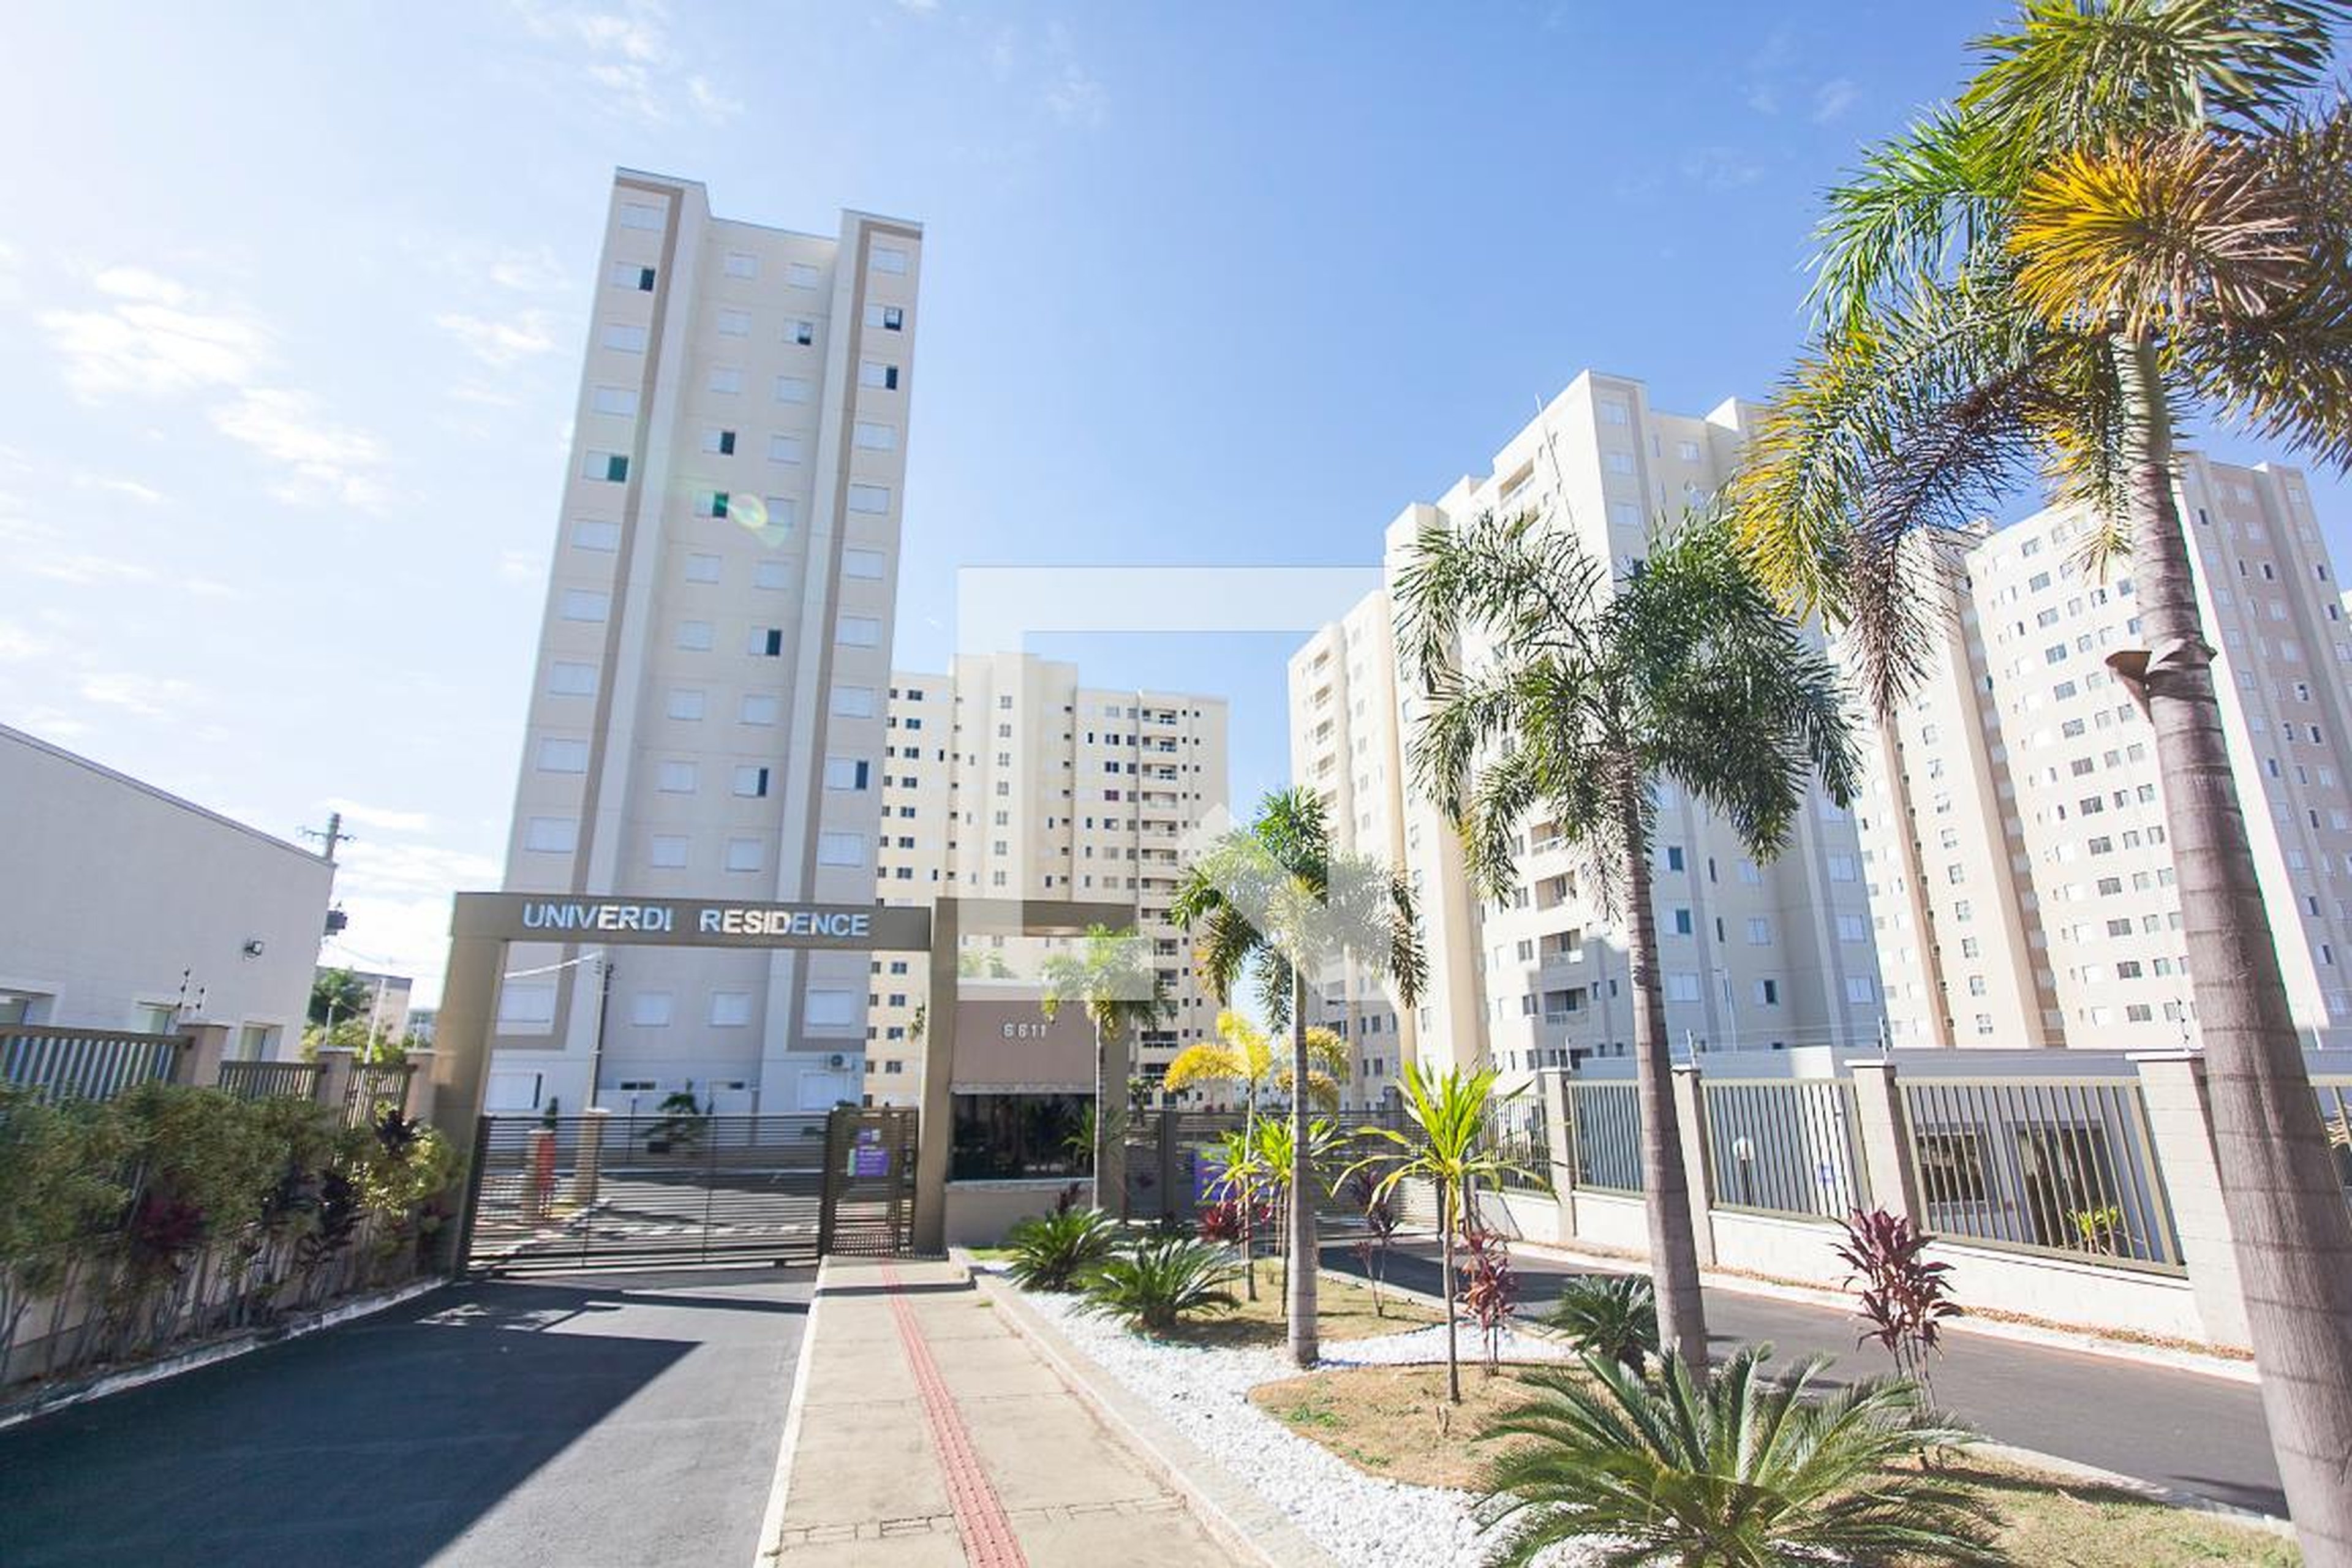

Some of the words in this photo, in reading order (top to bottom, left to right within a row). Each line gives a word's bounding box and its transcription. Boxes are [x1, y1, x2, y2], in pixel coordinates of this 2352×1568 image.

[522, 903, 671, 932] UNIVERDI
[699, 908, 869, 937] RESIDENCE
[1003, 1023, 1046, 1038] 6611
